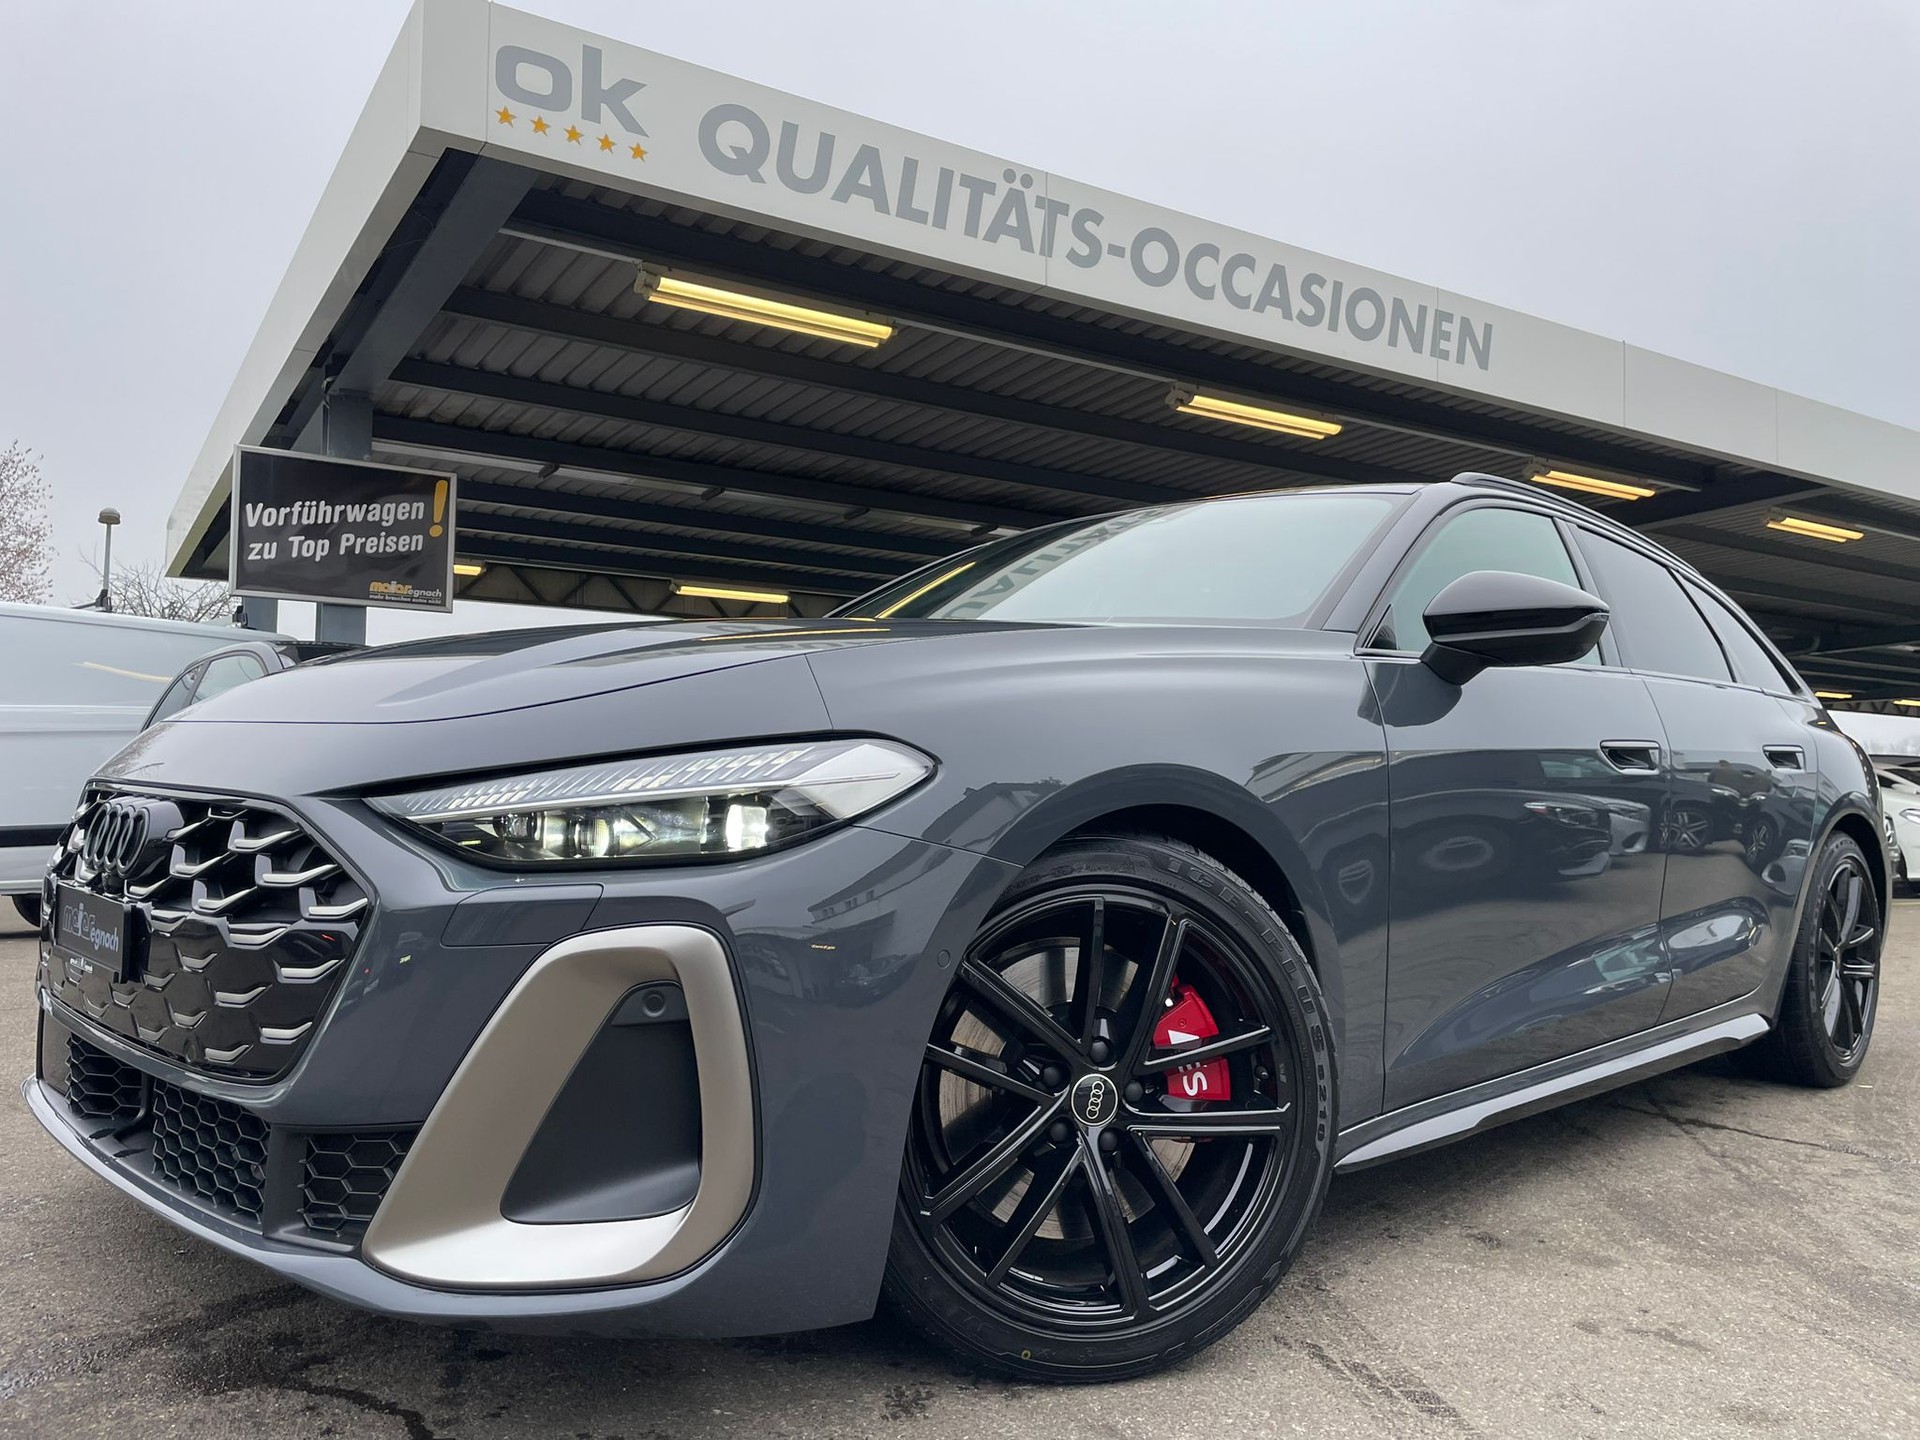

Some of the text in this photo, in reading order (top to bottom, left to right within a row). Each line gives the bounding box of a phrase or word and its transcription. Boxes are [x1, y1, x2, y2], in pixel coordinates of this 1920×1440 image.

[495, 43, 650, 138] ok
[697, 103, 1494, 372] QUALITÄTS-OCCASIONEN
[245, 500, 425, 527] Vorführwagen
[247, 531, 424, 562] zu Top Preisen
[90, 926, 119, 952] egnach
